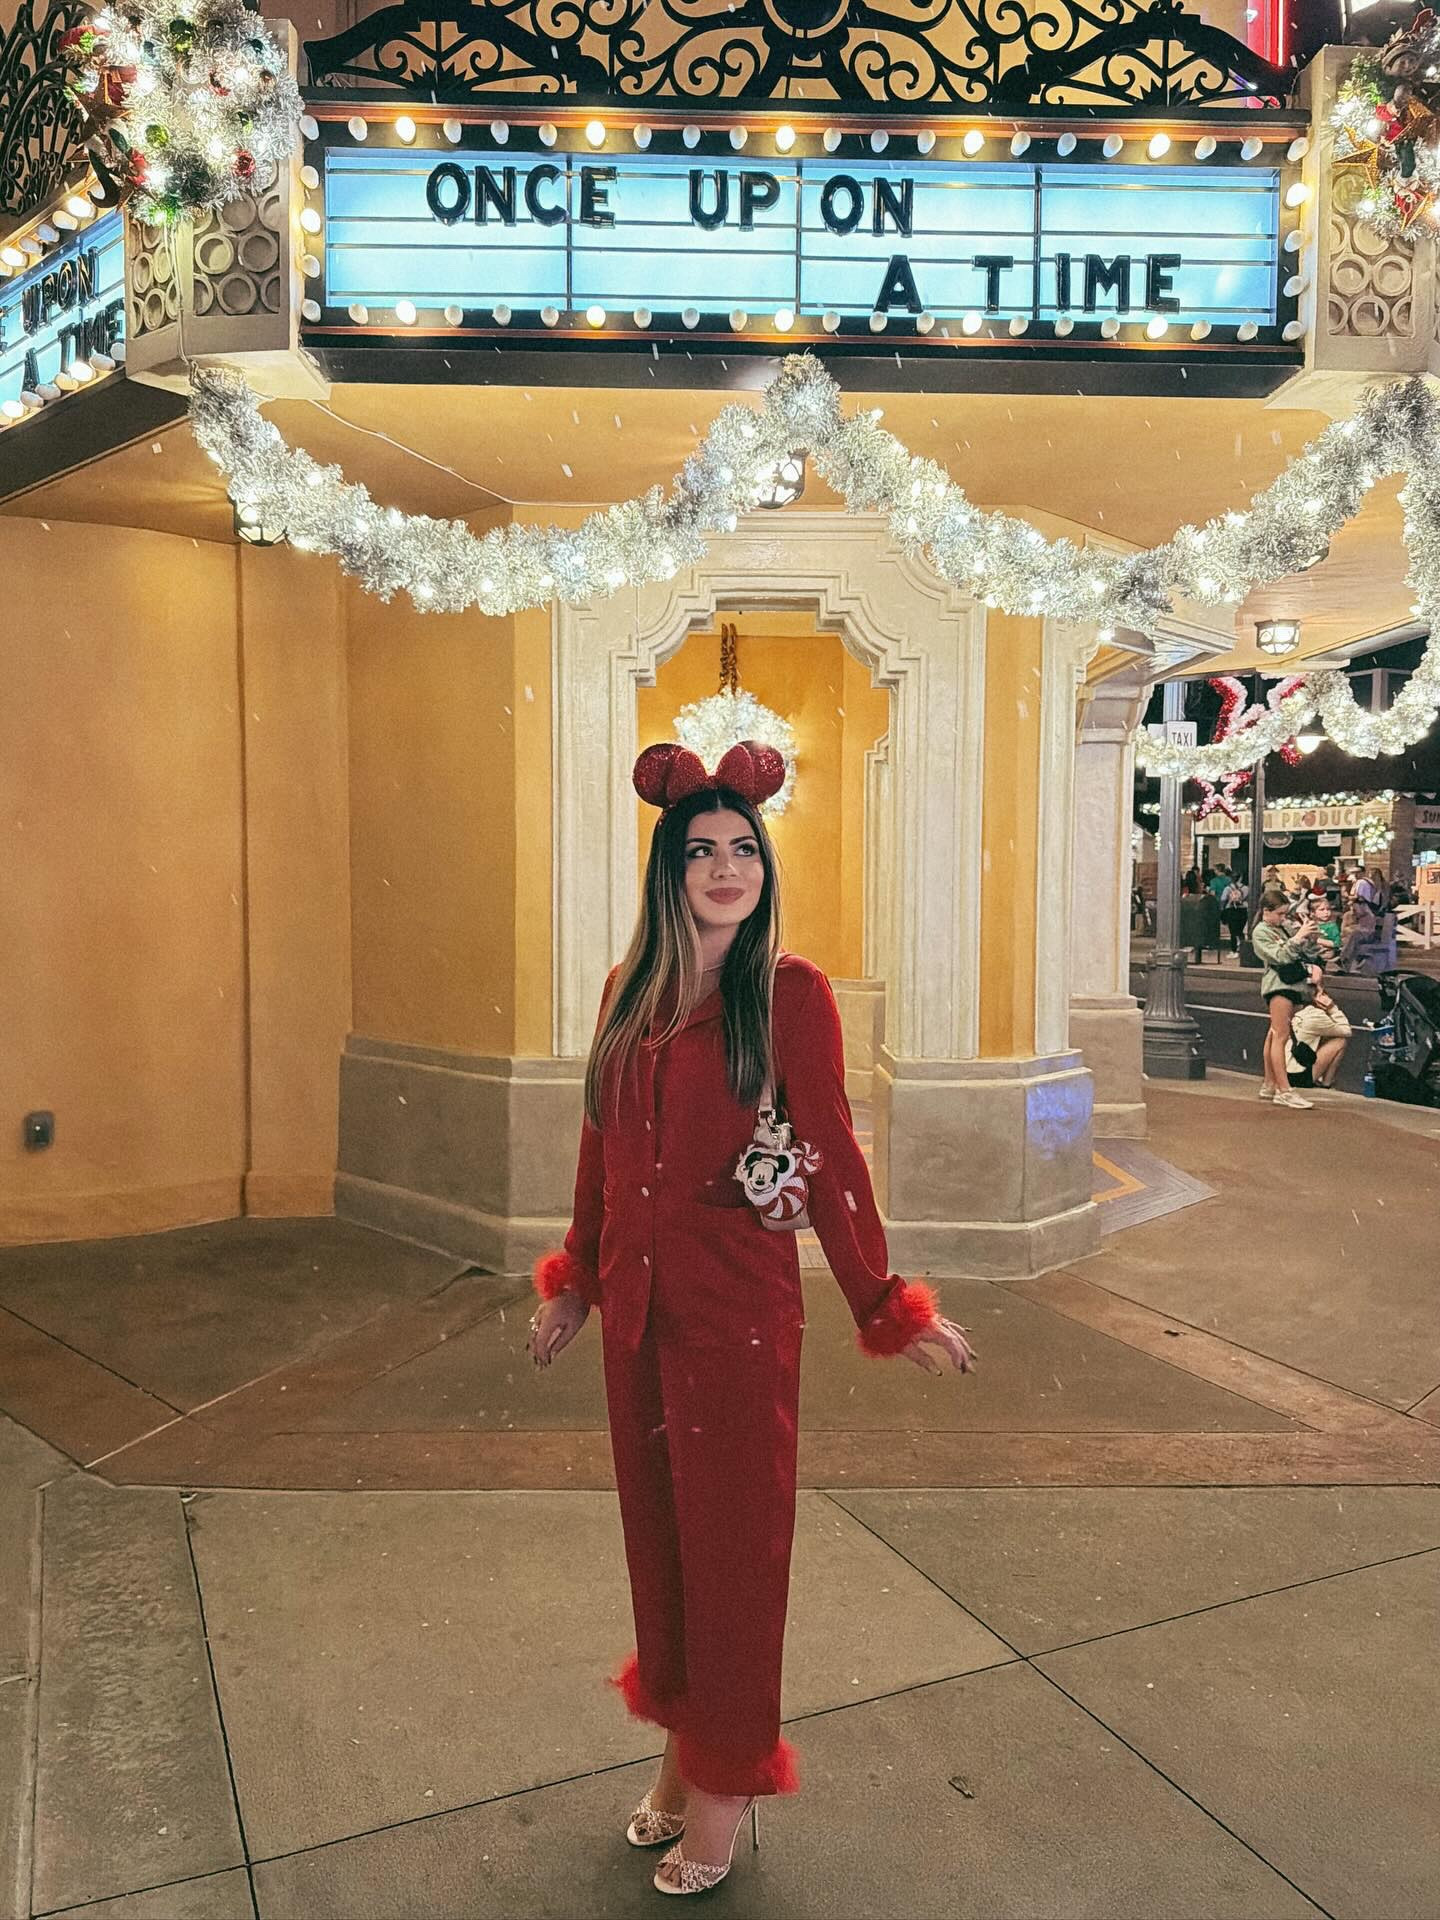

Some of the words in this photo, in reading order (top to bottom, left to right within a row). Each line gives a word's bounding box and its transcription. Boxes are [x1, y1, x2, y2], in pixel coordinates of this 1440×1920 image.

[426, 162, 618, 228] ONCE
[22, 245, 100, 337] UPON
[872, 254, 924, 315] A
[971, 252, 1182, 316] TIME
[1171, 731, 1193, 747] TAXI
